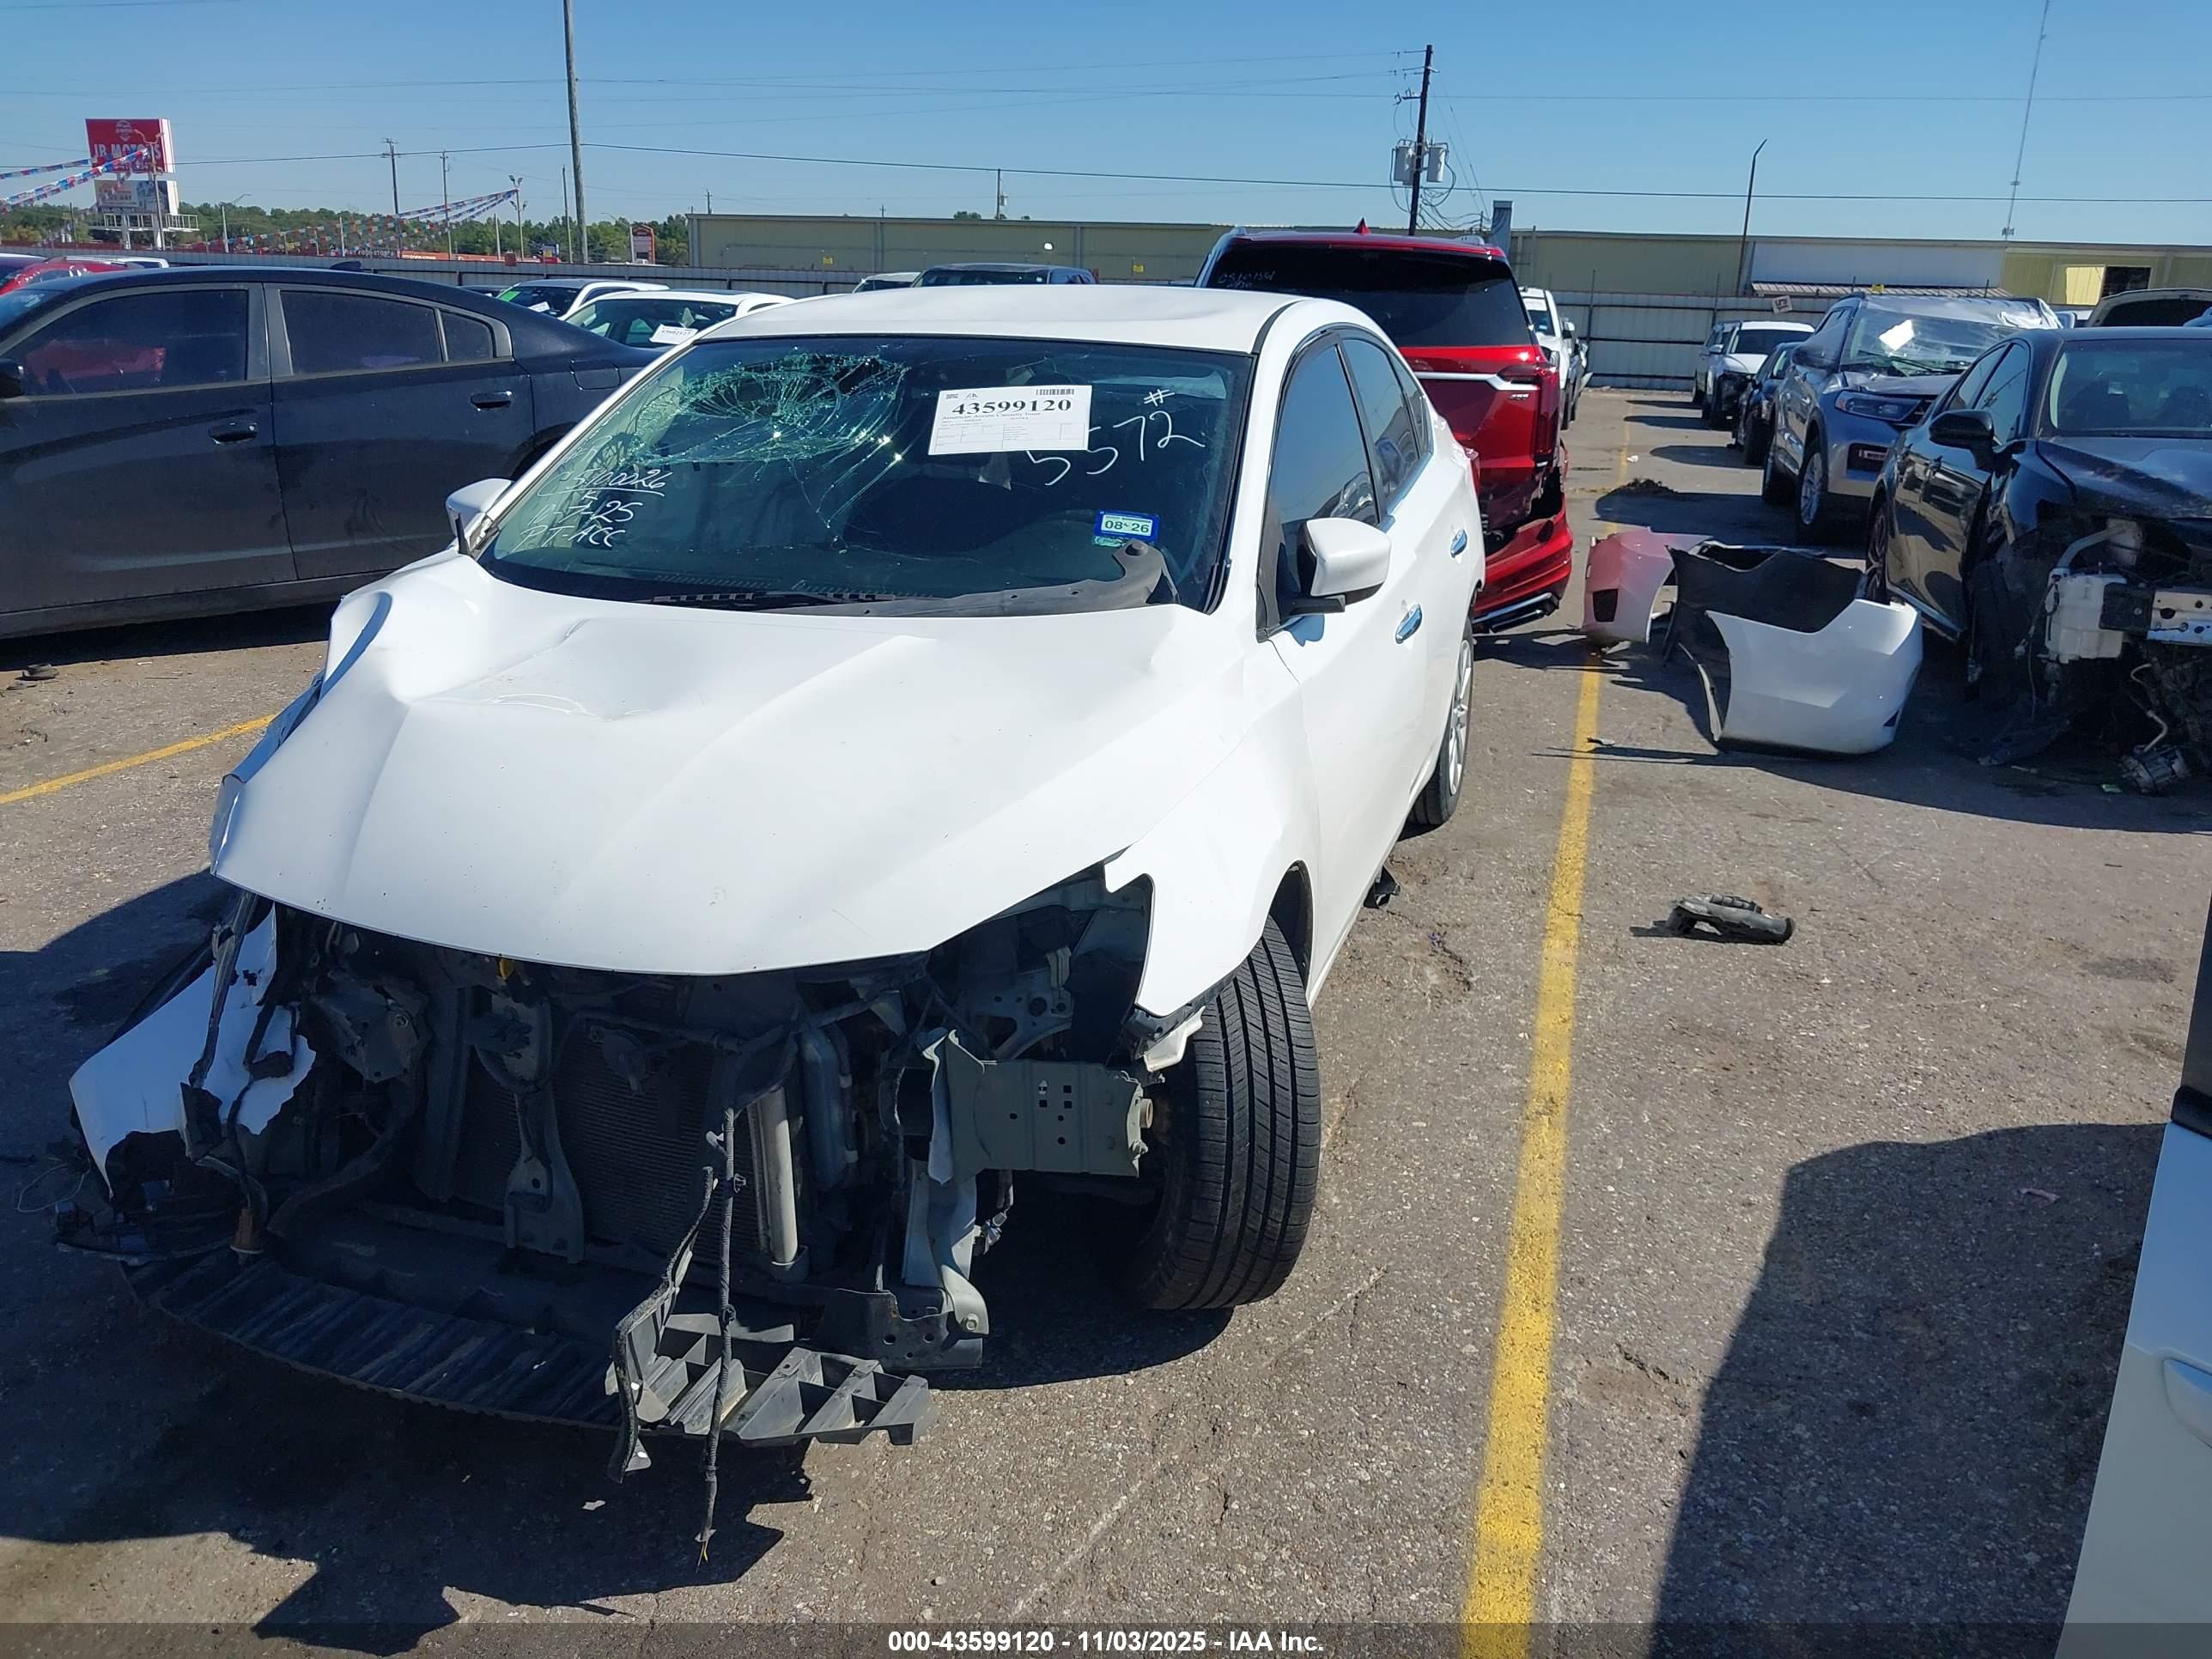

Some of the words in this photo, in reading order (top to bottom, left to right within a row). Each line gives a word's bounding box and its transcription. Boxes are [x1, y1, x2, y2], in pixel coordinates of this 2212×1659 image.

[952, 398, 1072, 415] 43599120
[1104, 520, 1123, 530] 08
[1130, 523, 1149, 532] 26
